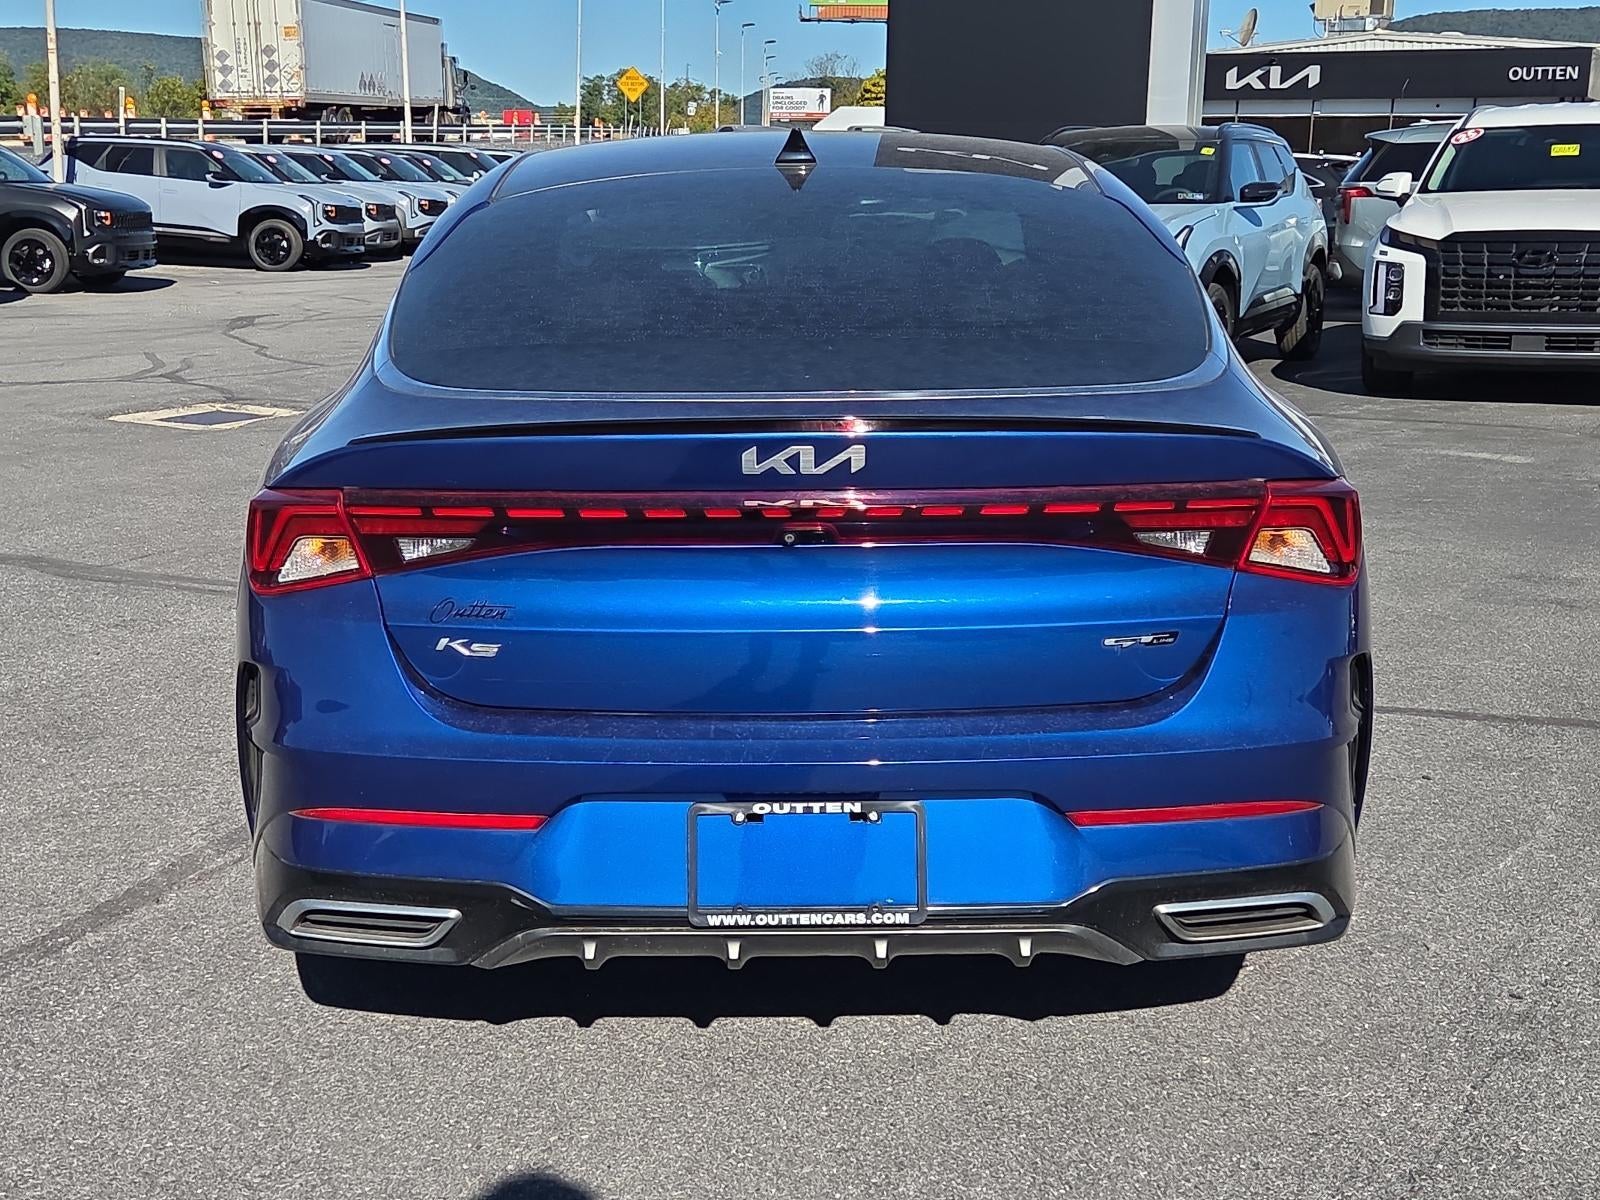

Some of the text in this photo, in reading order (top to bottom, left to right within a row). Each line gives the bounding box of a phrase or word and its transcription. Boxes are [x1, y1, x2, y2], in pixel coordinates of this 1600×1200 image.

[1225, 64, 1321, 90] KIA
[1508, 65, 1580, 81] OUTTEN
[741, 444, 866, 475] KIA
[429, 597, 516, 624] Outten
[1103, 634, 1170, 648] GT
[752, 802, 862, 814] OUTTEN
[706, 913, 910, 926] WWW.OUTTENCARS.COM
